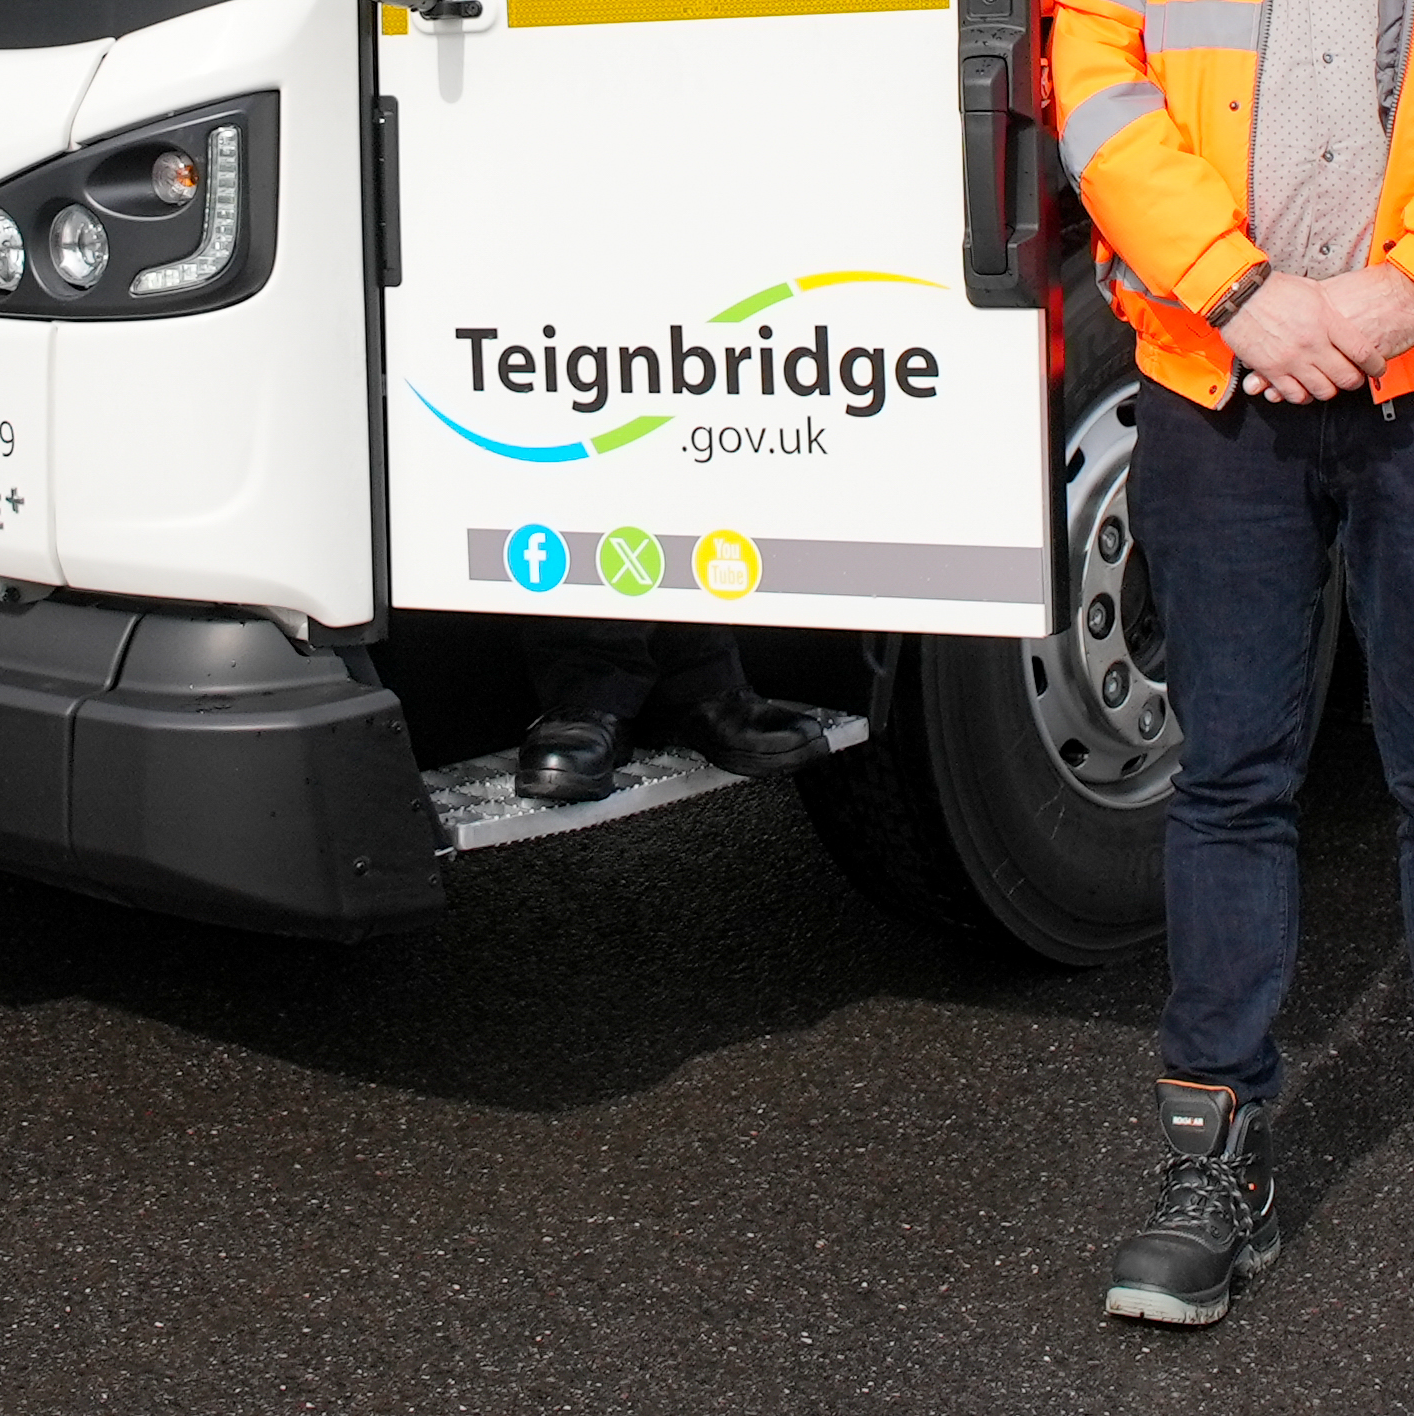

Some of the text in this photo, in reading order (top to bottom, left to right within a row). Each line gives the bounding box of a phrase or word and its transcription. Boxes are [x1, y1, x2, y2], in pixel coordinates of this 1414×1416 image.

[455, 324, 940, 418] Teignbridge
[681, 416, 828, 463] .gov.uk
[714, 537, 740, 559] You
[711, 562, 745, 585] Tube
